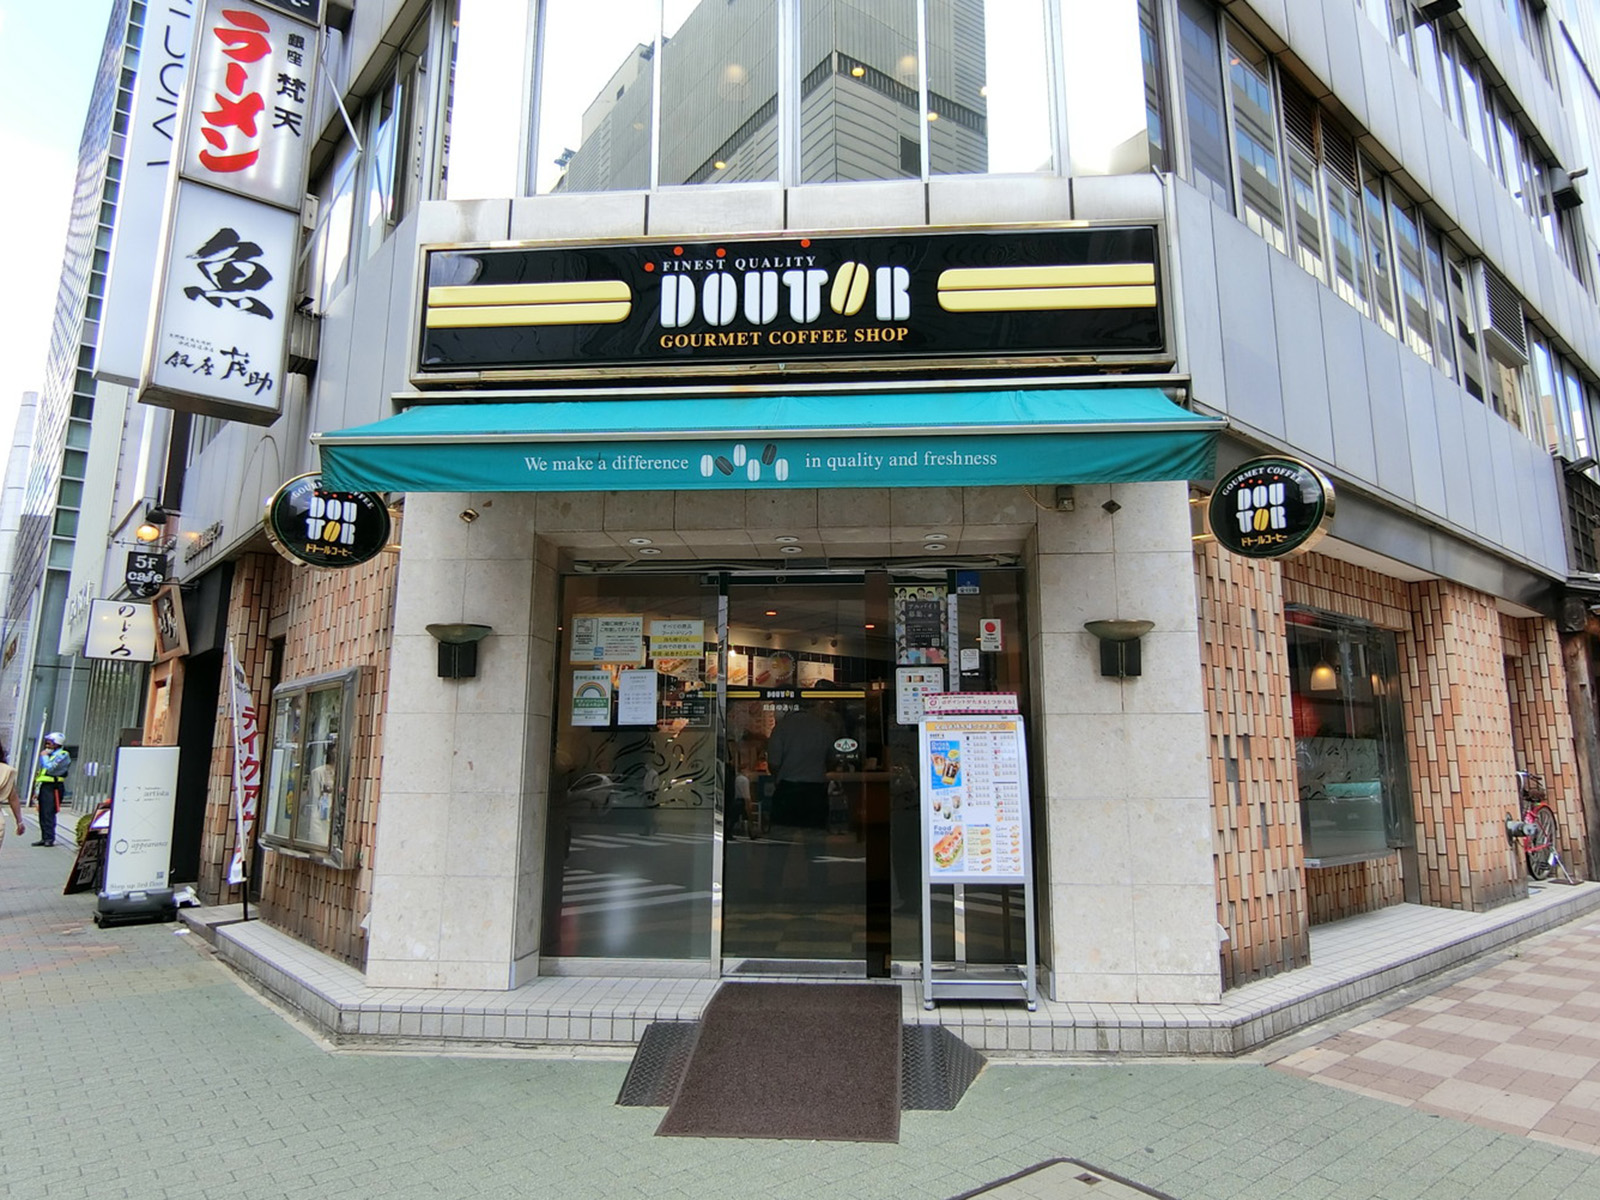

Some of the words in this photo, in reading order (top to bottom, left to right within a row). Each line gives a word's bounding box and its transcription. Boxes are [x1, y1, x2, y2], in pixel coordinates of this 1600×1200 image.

[199, 10, 272, 172] ラーメン
[184, 228, 273, 319] 魚
[662, 259, 726, 271] FINEST
[735, 255, 817, 270] QUALITY
[660, 261, 911, 328] DOUTOR
[660, 332, 761, 348] GOURMET
[768, 329, 848, 344] COFFEE
[854, 327, 909, 342] SHOP
[524, 457, 548, 471] We
[552, 456, 594, 471] make
[598, 460, 607, 470] a
[612, 455, 689, 470] difference
[805, 453, 821, 468] in
[826, 452, 883, 471] quality
[889, 452, 918, 467] and
[923, 451, 998, 466] freshness
[1222, 466, 1265, 496] GOURMET
[1267, 466, 1304, 484] COFFEE
[1237, 482, 1285, 510] DOU
[309, 496, 357, 522] DOU
[1235, 506, 1287, 533] TOR
[305, 518, 356, 545] TOR
[1241, 533, 1288, 547] ドトールコーヒー
[305, 543, 353, 557] ドトールコーヒー
[135, 555, 158, 569] 5F
[127, 570, 163, 583] cafe
[766, 690, 795, 698] DOUTOR
